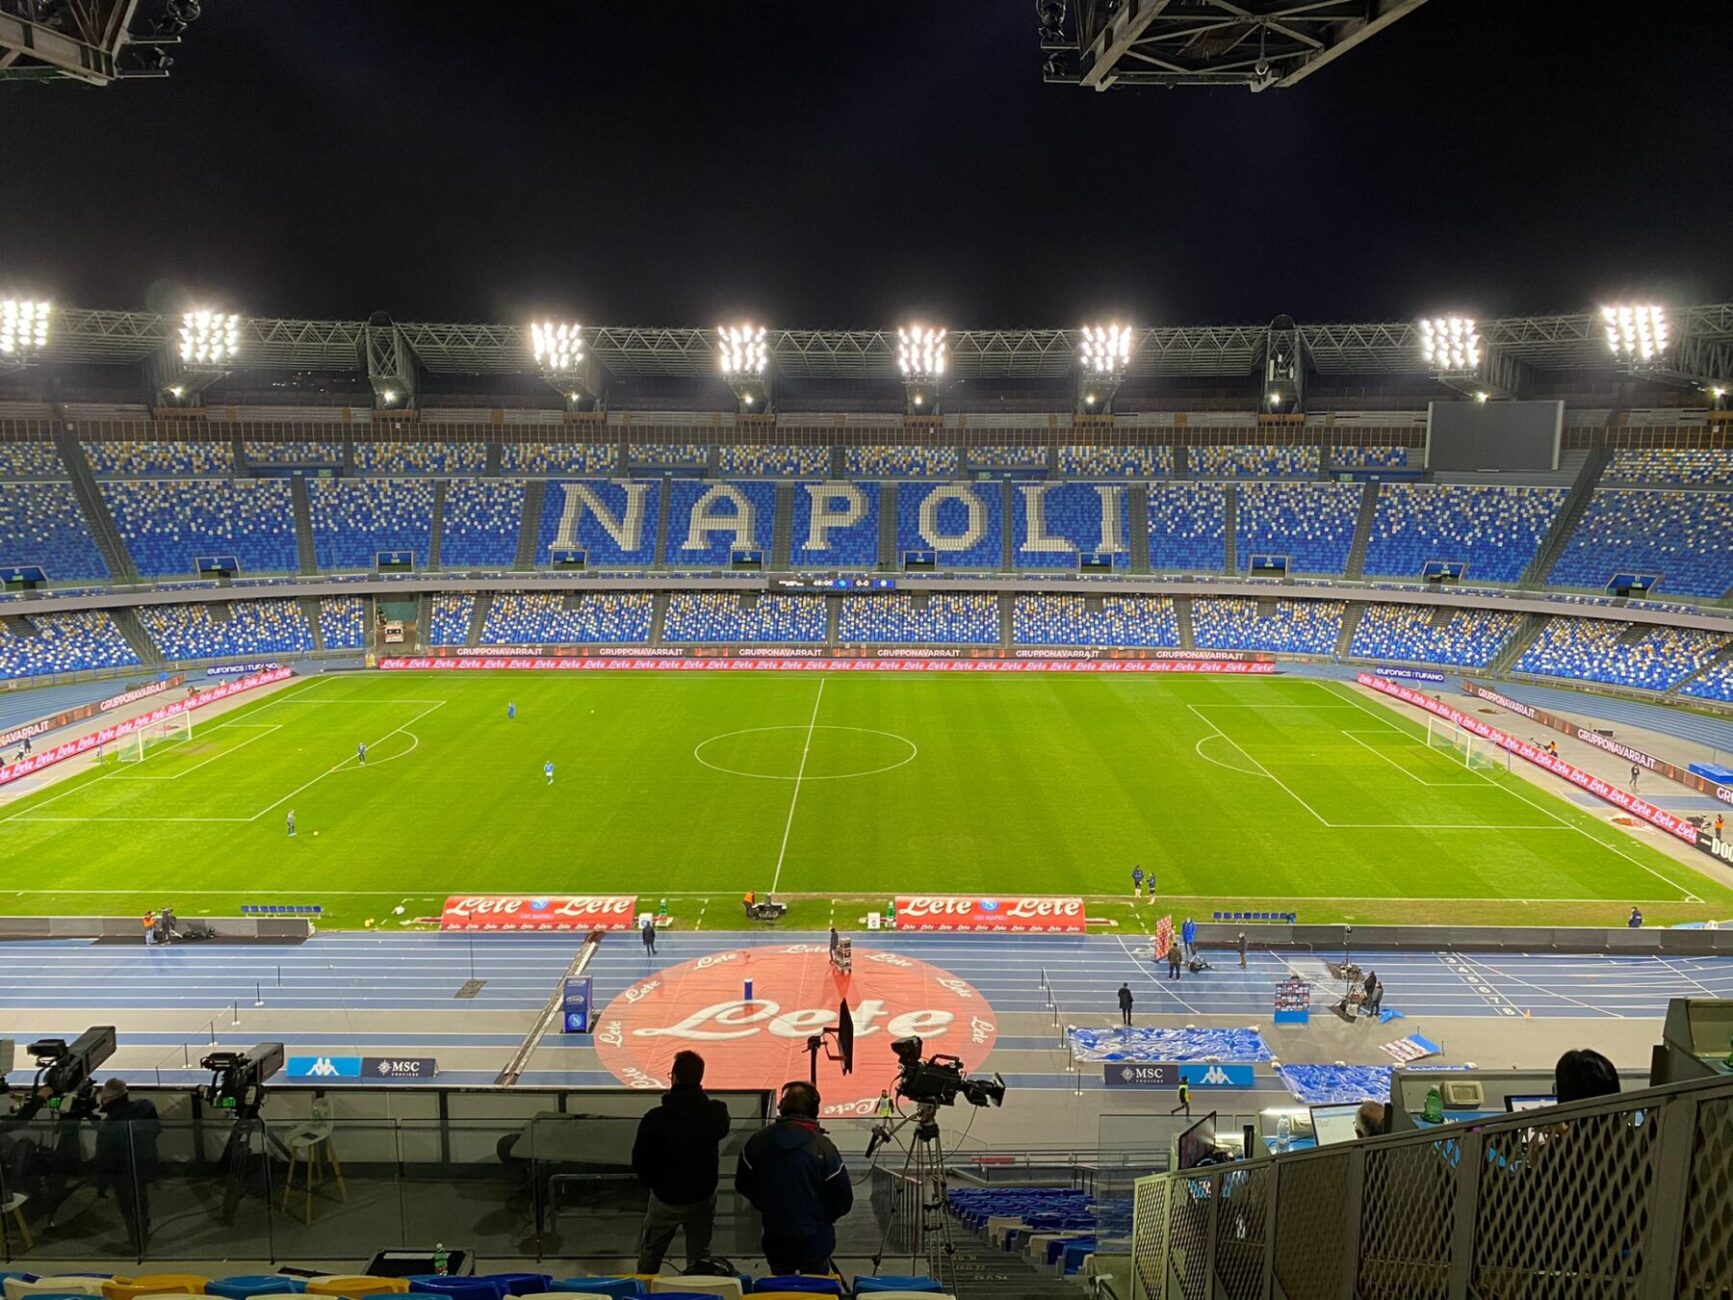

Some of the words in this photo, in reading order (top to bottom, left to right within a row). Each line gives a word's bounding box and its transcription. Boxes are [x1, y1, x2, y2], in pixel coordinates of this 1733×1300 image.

[547, 482, 1130, 552] NAPOLI
[456, 648, 543, 656] GRUPPONAVARRA.IT
[600, 648, 683, 656] GRUPPONAVARRA.IT
[739, 649, 822, 657] GRUPPONAVARRA.IT
[877, 649, 960, 657] GRUPPONAVARRA.IT
[1016, 650, 1100, 659] GRUPPONAVARRA.IT
[1156, 651, 1244, 660] GRUPPONAVARRA.IT
[207, 666, 244, 675] euronics
[1376, 668, 1411, 677] euronics
[1415, 671, 1444, 681] TUFANO
[1578, 728, 1655, 769] GRUPPONAVARRA.IT
[445, 897, 522, 916] Lete
[554, 897, 630, 916] Lete
[899, 898, 972, 916] Lete
[1006, 898, 1080, 918] Lete
[782, 944, 829, 954] Lete
[693, 953, 738, 970] Lete
[865, 953, 913, 967] Lete
[624, 979, 661, 1004] Lete
[936, 977, 972, 998] Lete
[632, 999, 954, 1040] Lete
[1502, 1007, 1515, 1015] 8
[599, 1020, 623, 1048] Lete
[970, 1016, 995, 1044] Lete
[391, 1061, 420, 1072] MSC
[1135, 1068, 1163, 1078] MSC
[622, 1066, 668, 1089] Lete
[824, 1097, 881, 1114] Lete
